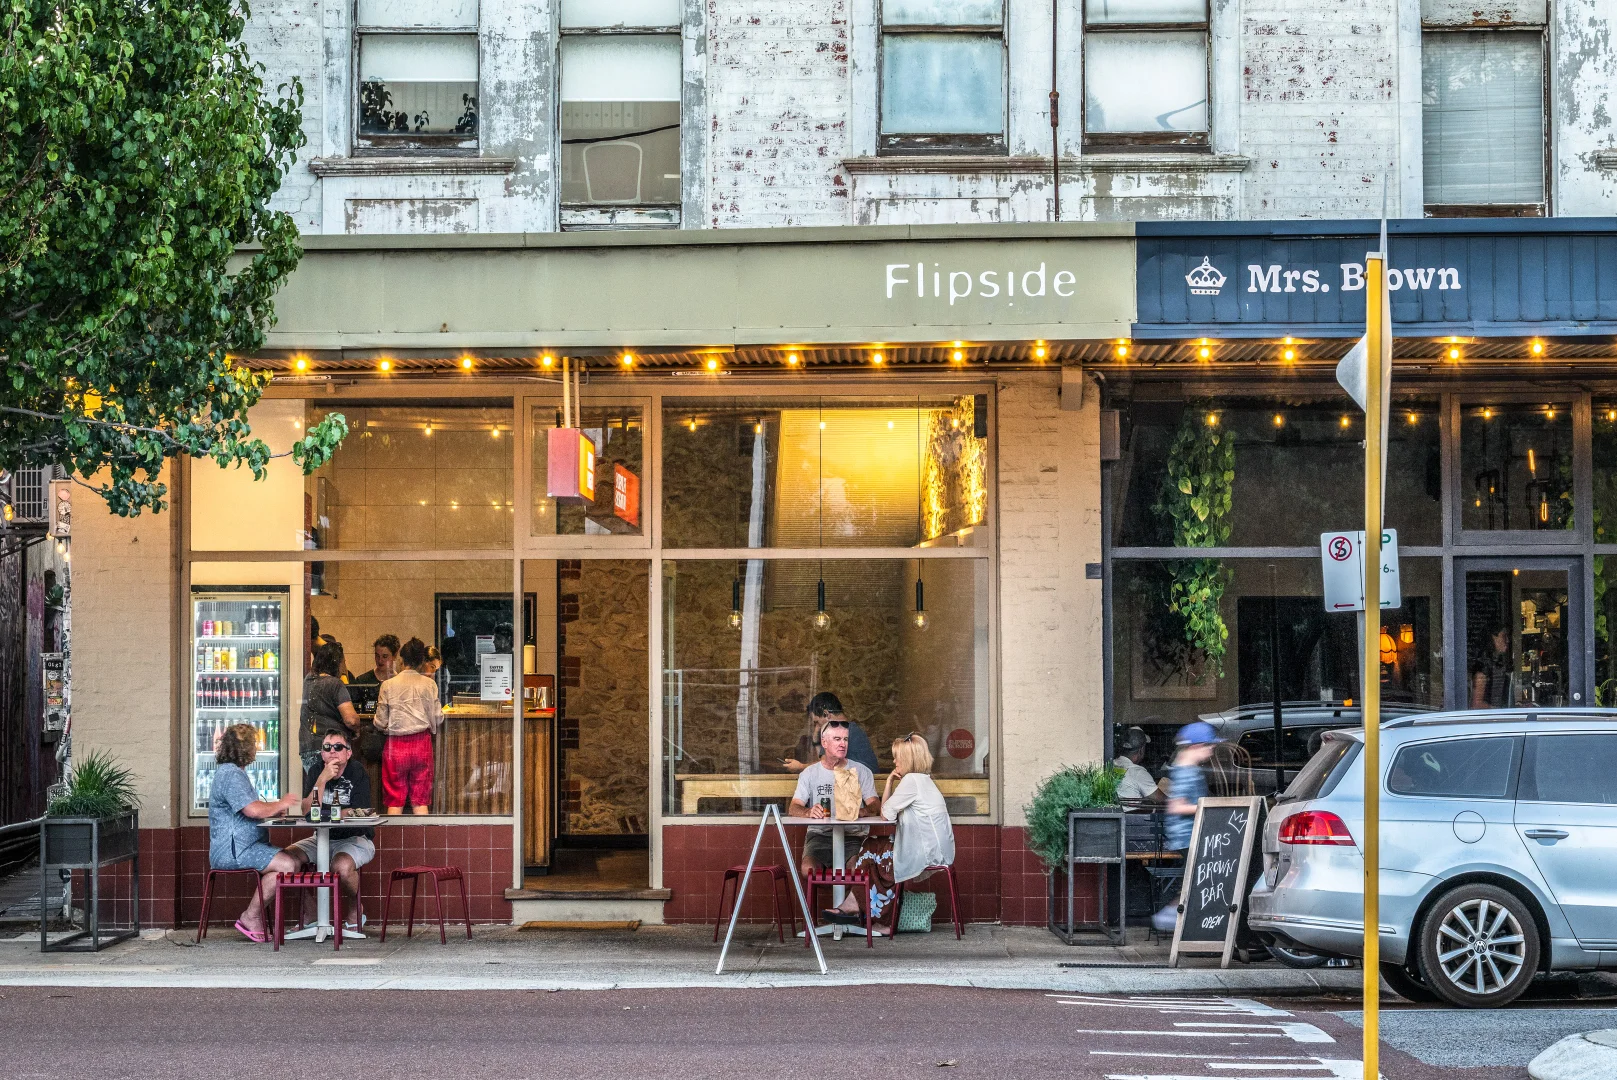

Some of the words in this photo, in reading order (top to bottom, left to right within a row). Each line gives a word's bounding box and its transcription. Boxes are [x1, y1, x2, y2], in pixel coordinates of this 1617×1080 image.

[886, 262, 1077, 306] Flipside
[1247, 264, 1330, 293] Mrs.
[1340, 263, 1462, 291] Bown
[1203, 833, 1231, 858] MRS
[1196, 858, 1237, 887] BROWN
[1200, 882, 1229, 910] BAR
[1201, 914, 1225, 929] OPEN
